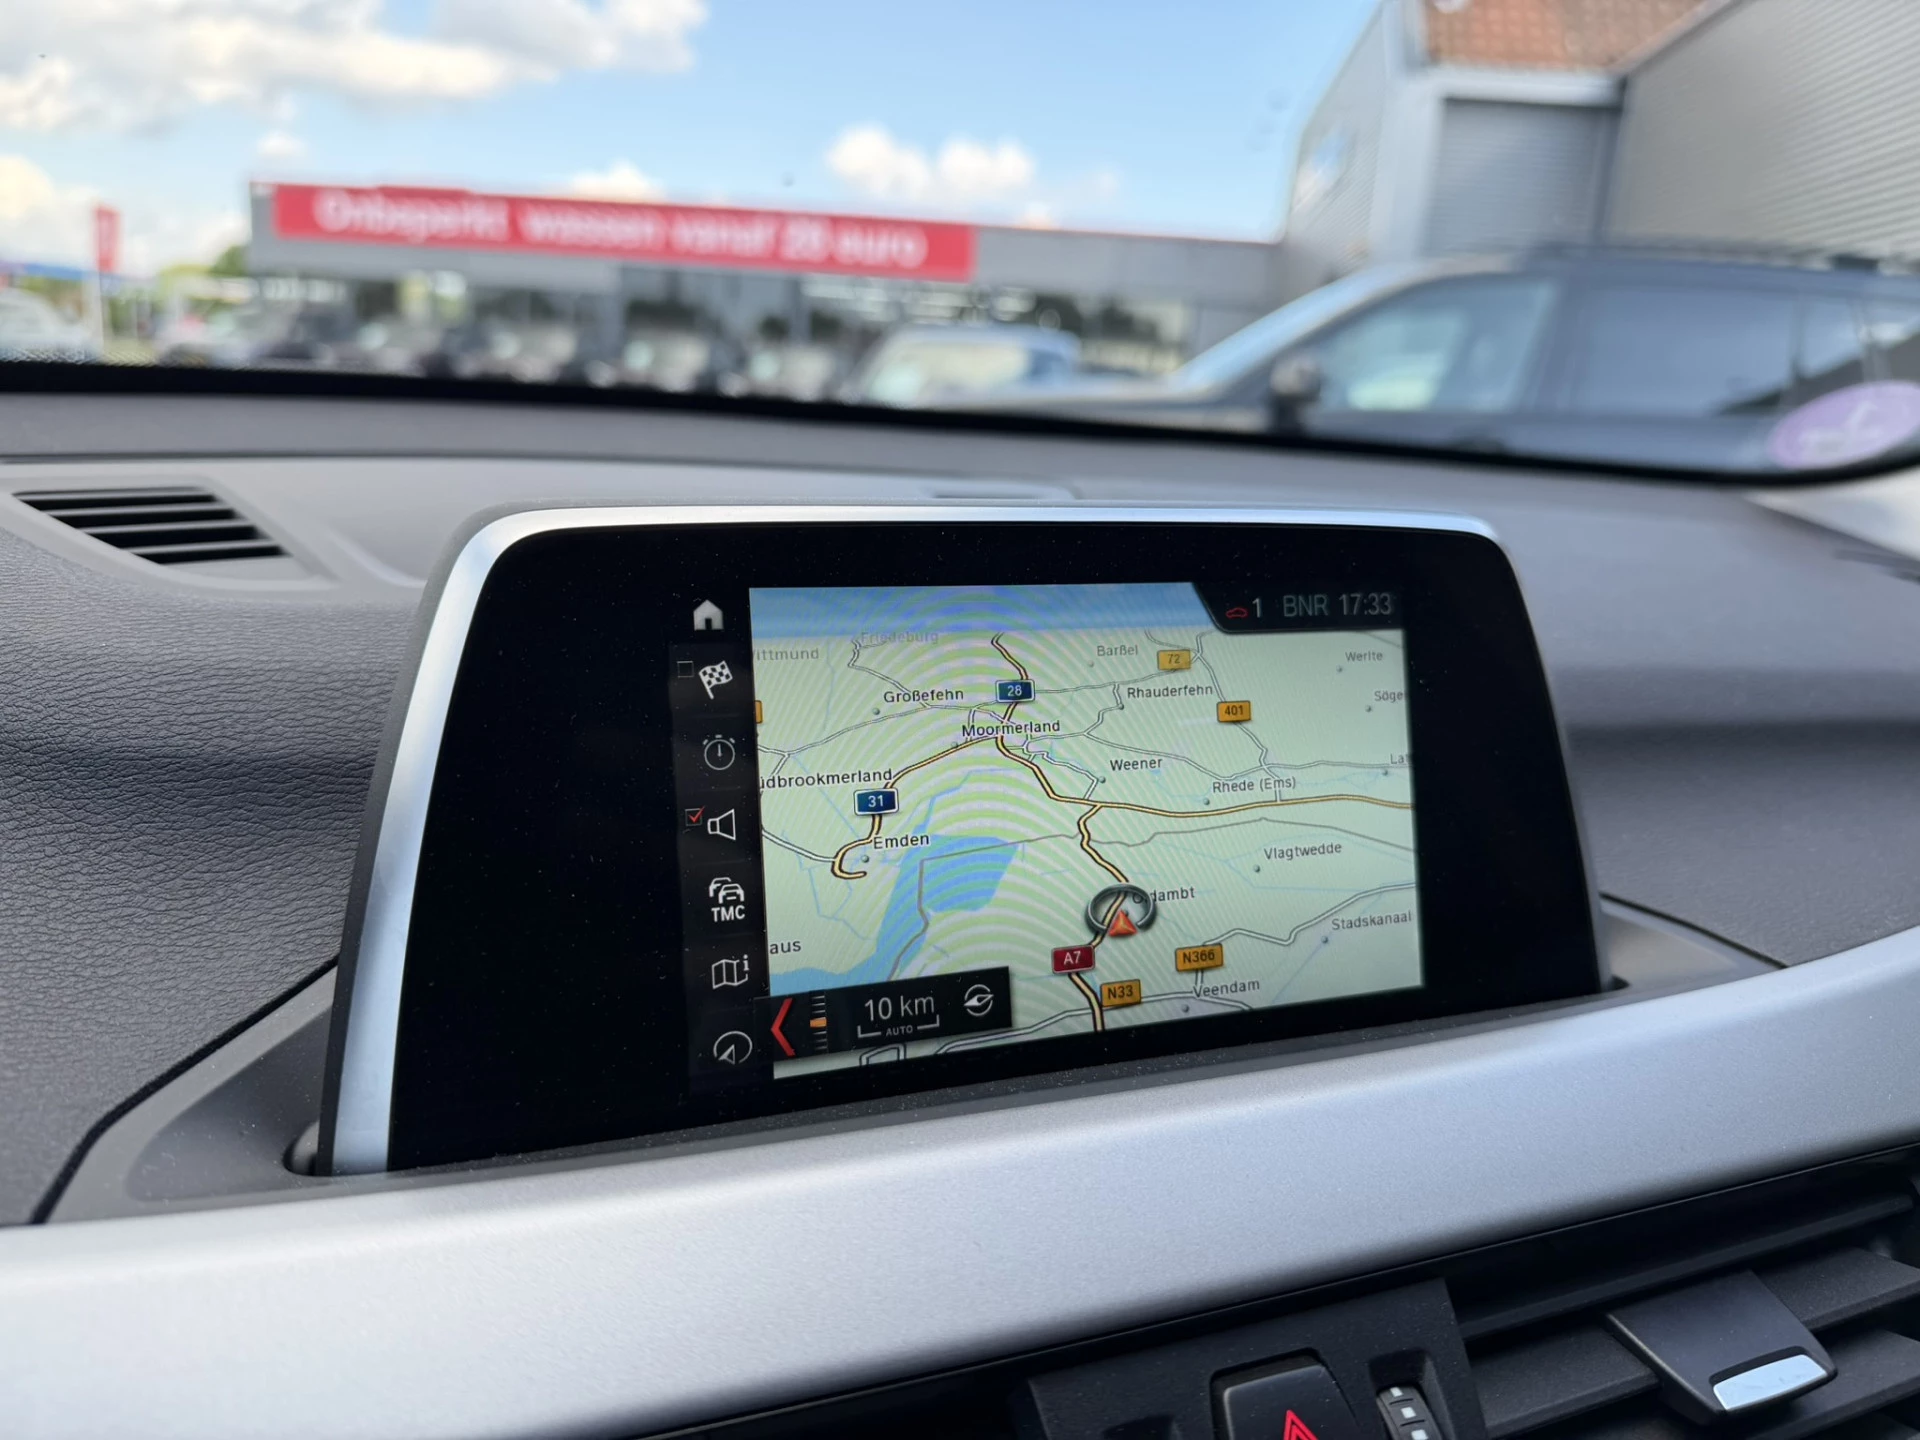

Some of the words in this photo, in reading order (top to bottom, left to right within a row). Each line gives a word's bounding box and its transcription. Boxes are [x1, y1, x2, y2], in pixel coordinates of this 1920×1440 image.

[1252, 599, 1262, 618] 1
[1283, 596, 1329, 617] BNR
[1339, 593, 1393, 616] 17:33
[861, 632, 939, 645] Friedeburg
[753, 648, 819, 661] ittmund
[1167, 653, 1181, 665] 72
[1345, 651, 1384, 662] Werlte
[883, 688, 964, 703] Großefehn
[1007, 685, 1022, 696] 28
[1127, 683, 1213, 699] Rhauderfehn
[1374, 690, 1406, 704] Söge
[1224, 704, 1244, 717] 401
[962, 720, 1061, 737] Moormerland
[1110, 757, 1163, 771] Weener
[1213, 779, 1255, 793] Rhede
[1259, 776, 1296, 791] (Ems)
[868, 796, 884, 807] 31
[873, 832, 930, 849] Emden
[1264, 841, 1342, 861] Vlagtwedde
[1132, 886, 1196, 904] Odambt
[711, 905, 746, 922] TMC
[1332, 909, 1413, 931] Stadskanaal
[1063, 950, 1082, 965] A7
[1182, 949, 1215, 966] N366
[1107, 984, 1134, 999] N33
[1193, 978, 1260, 998] Veendam
[864, 997, 893, 1022] 10
[900, 994, 935, 1018] km
[885, 1024, 913, 1037] AUTO
